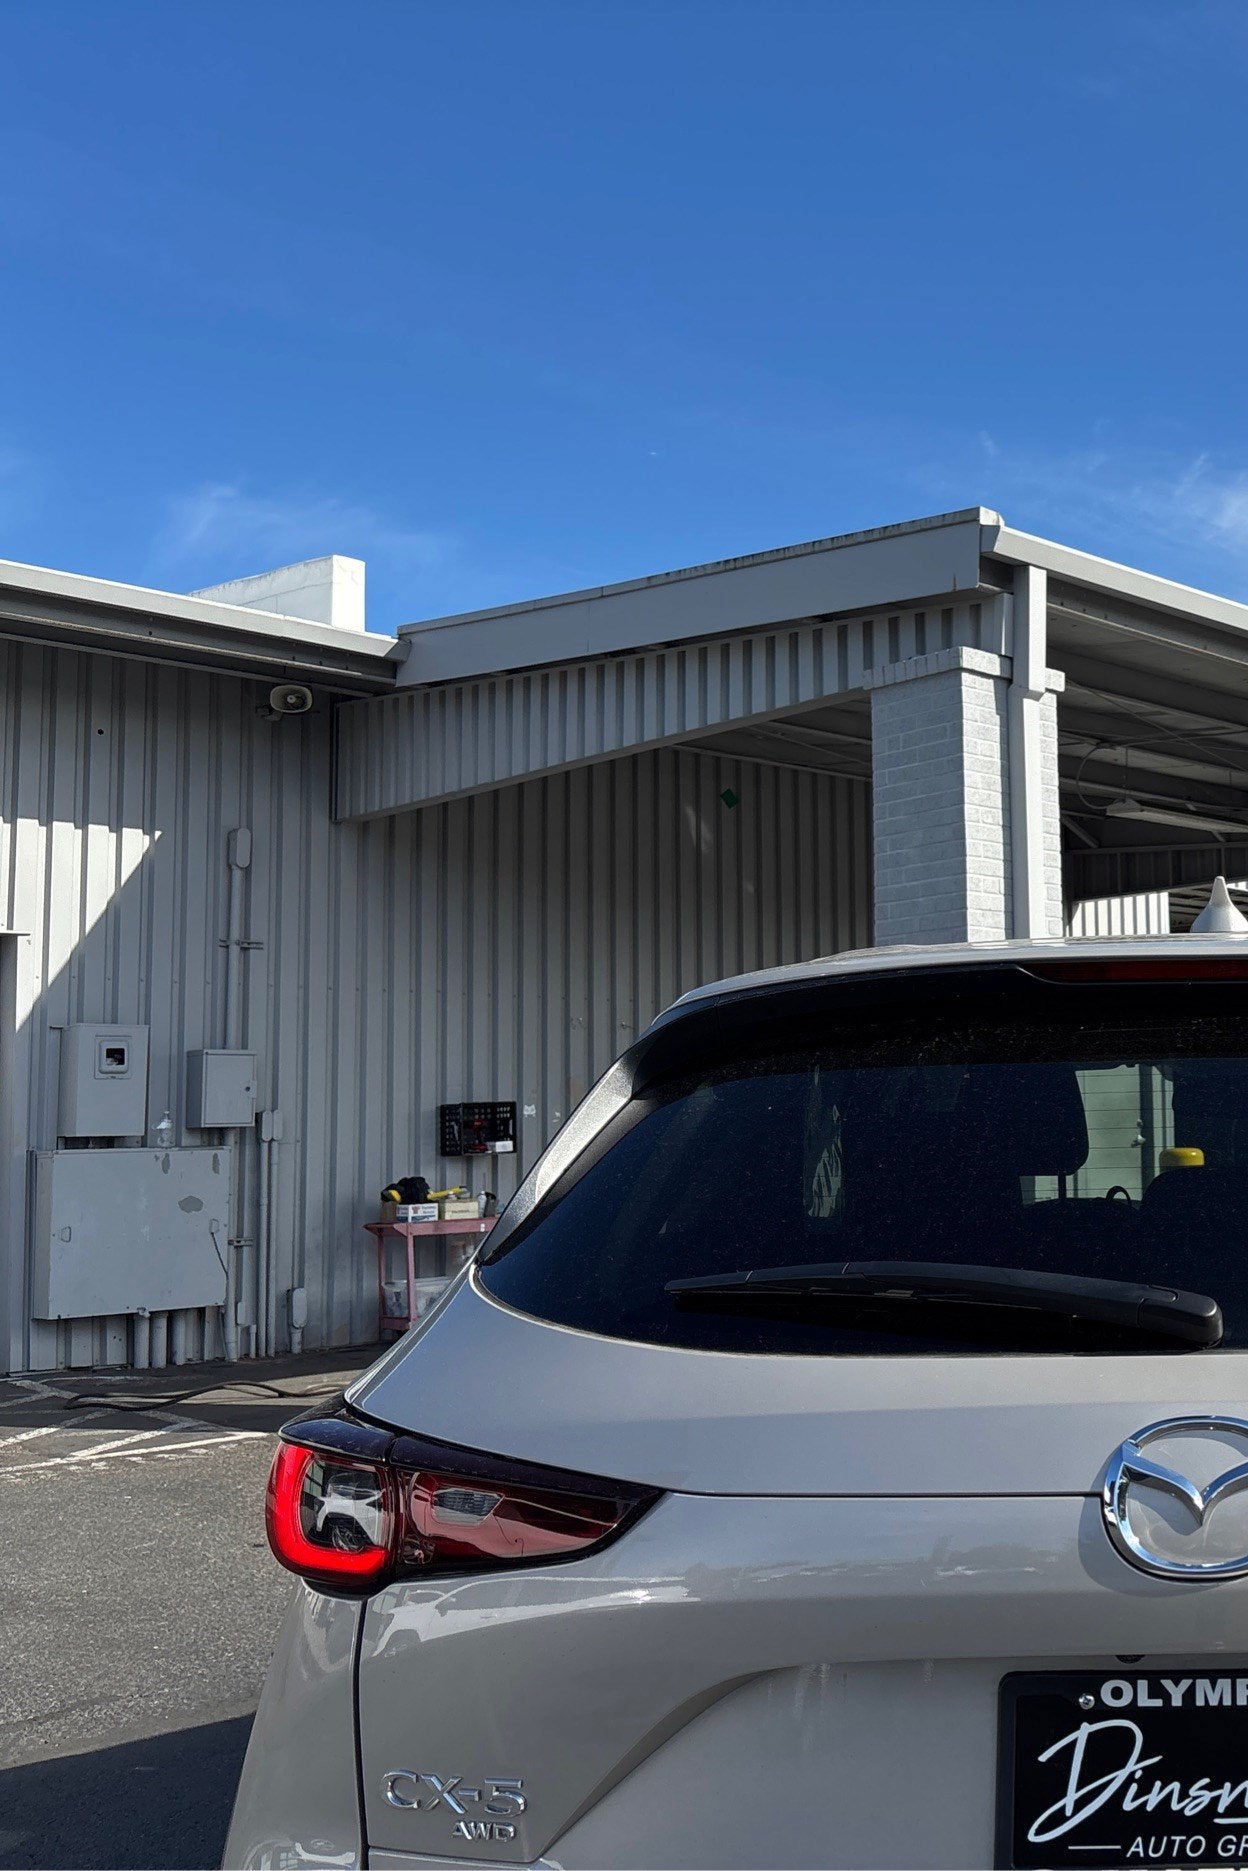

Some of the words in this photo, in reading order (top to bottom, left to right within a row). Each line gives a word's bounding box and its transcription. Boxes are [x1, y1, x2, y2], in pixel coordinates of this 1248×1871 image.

[381, 1769, 527, 1817] CX-5
[452, 1820, 516, 1842] AWD
[1126, 1836, 1206, 1858] AUTO
